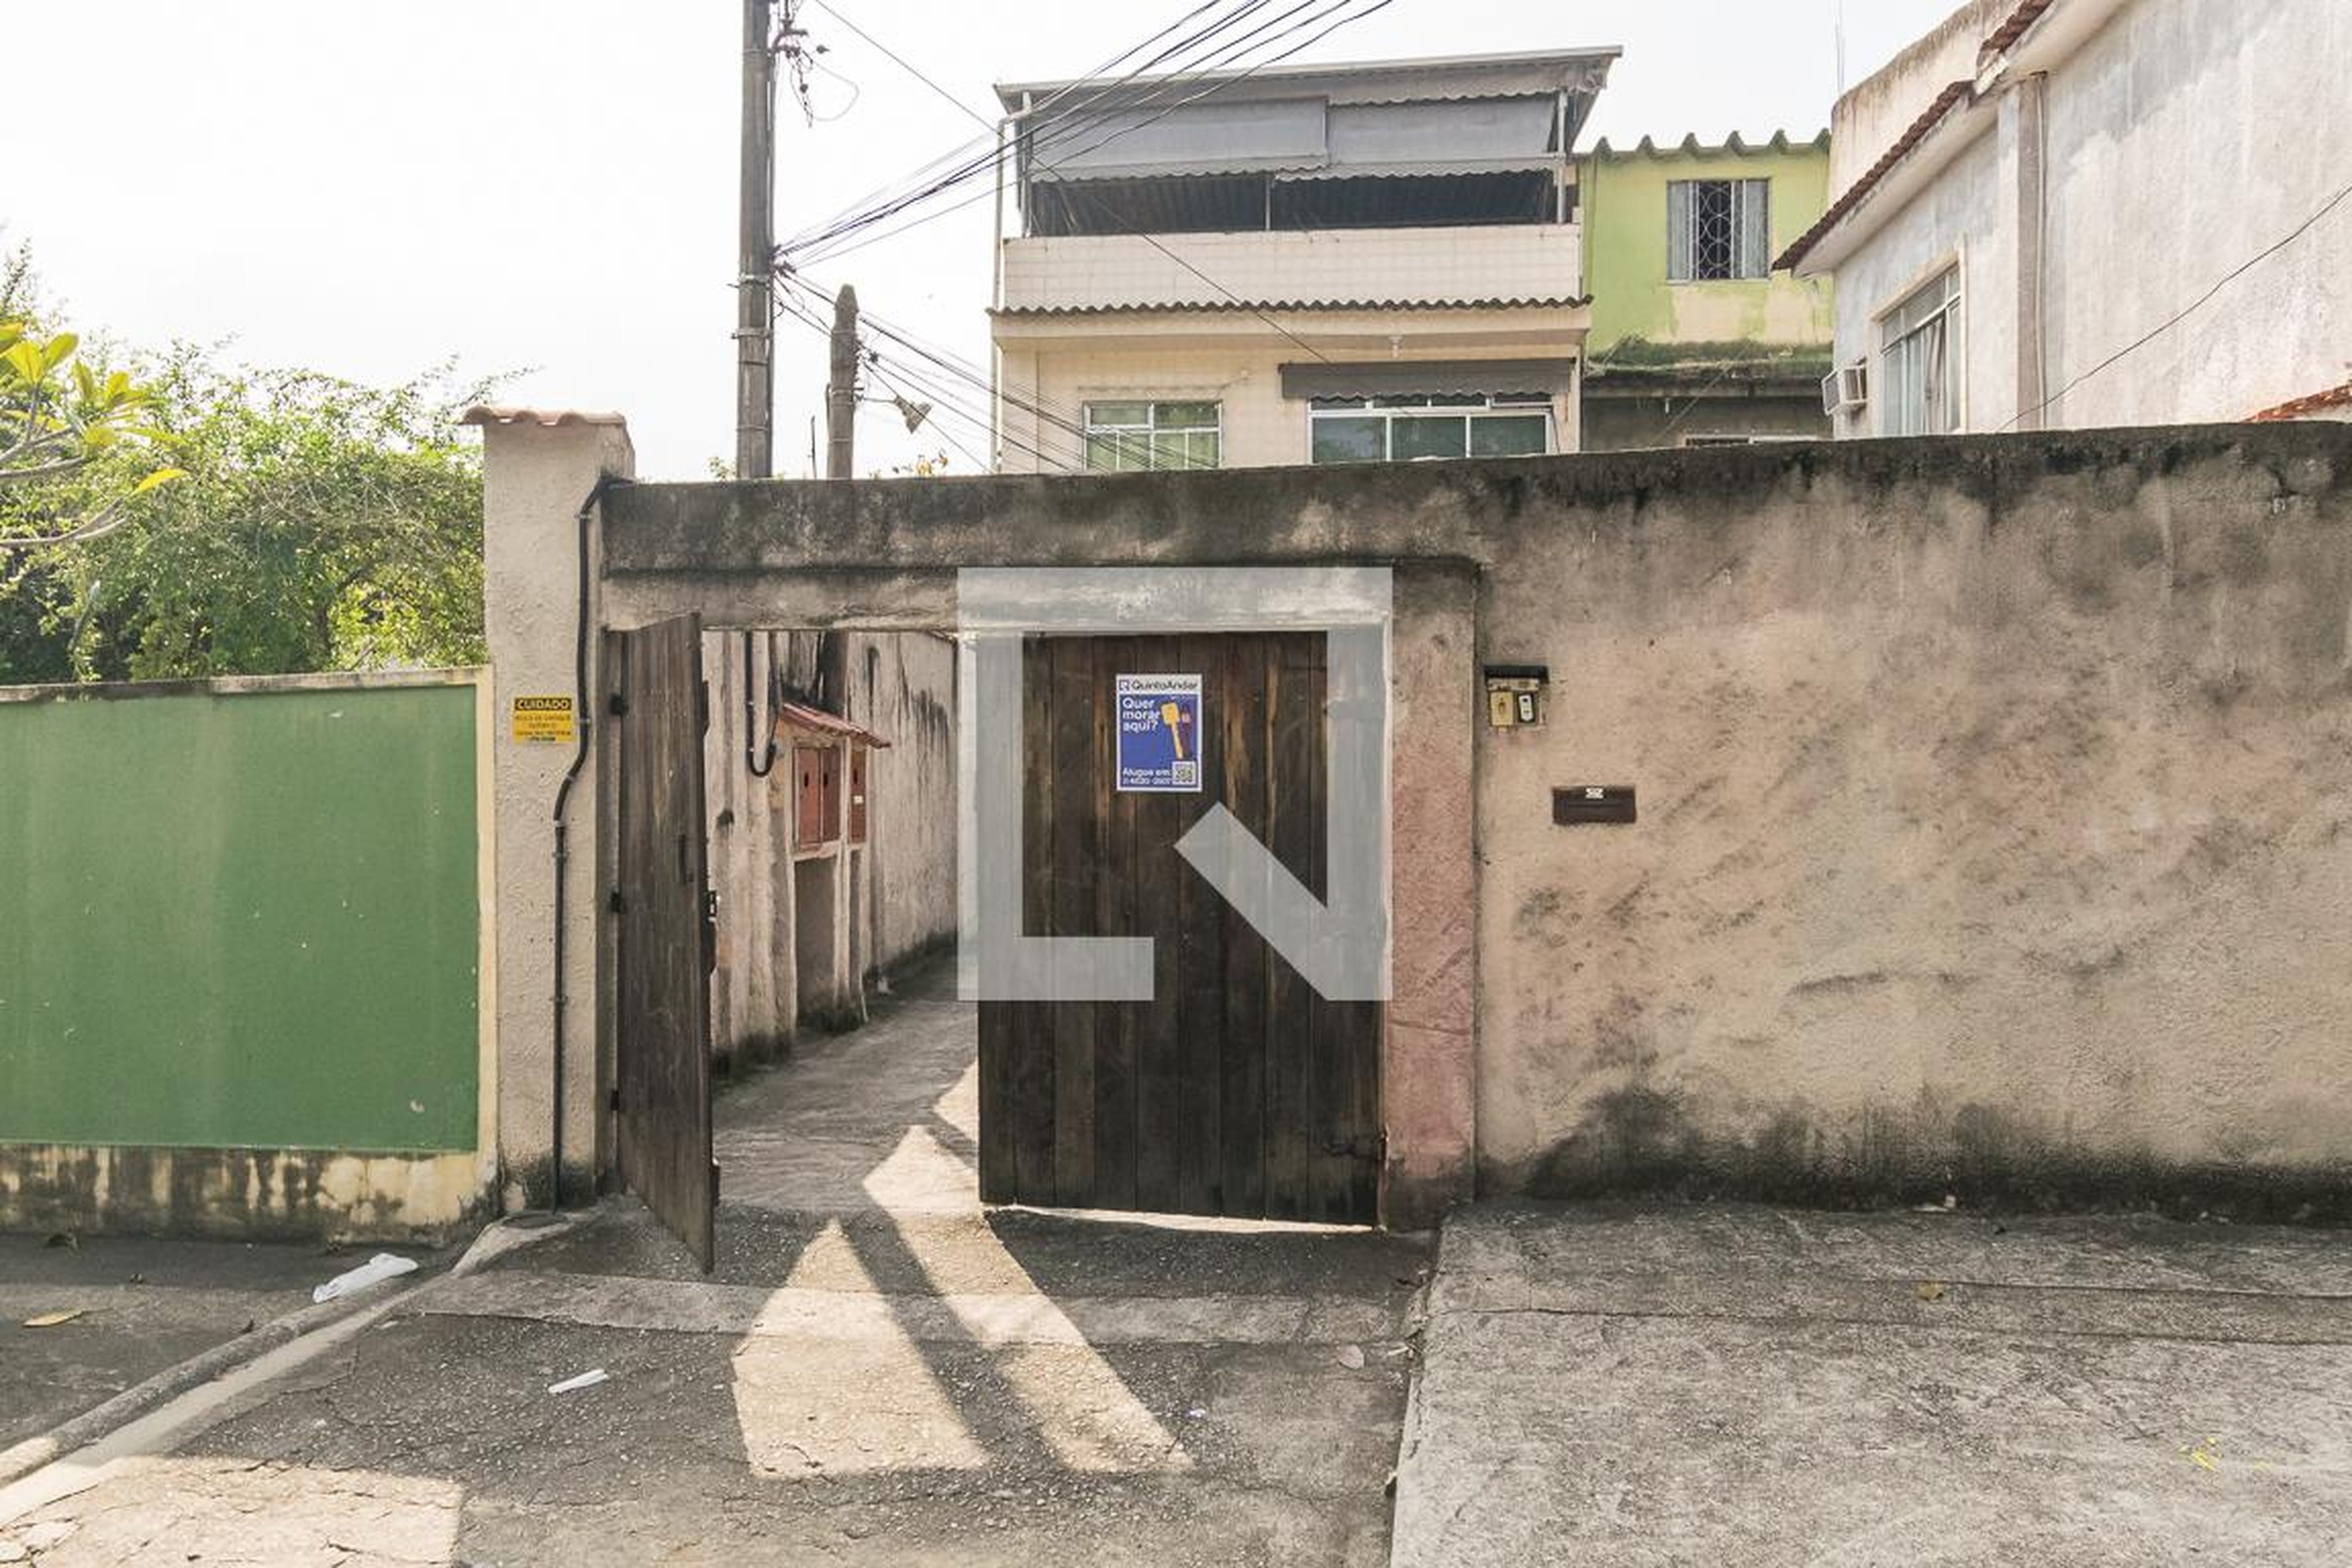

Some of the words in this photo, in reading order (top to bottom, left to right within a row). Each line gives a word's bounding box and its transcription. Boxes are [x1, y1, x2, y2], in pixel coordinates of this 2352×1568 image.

[517, 699, 570, 709] CUIDADO
[1122, 697, 1155, 709] Quer
[1122, 710, 1161, 720] morar
[1122, 720, 1158, 733] aqui?
